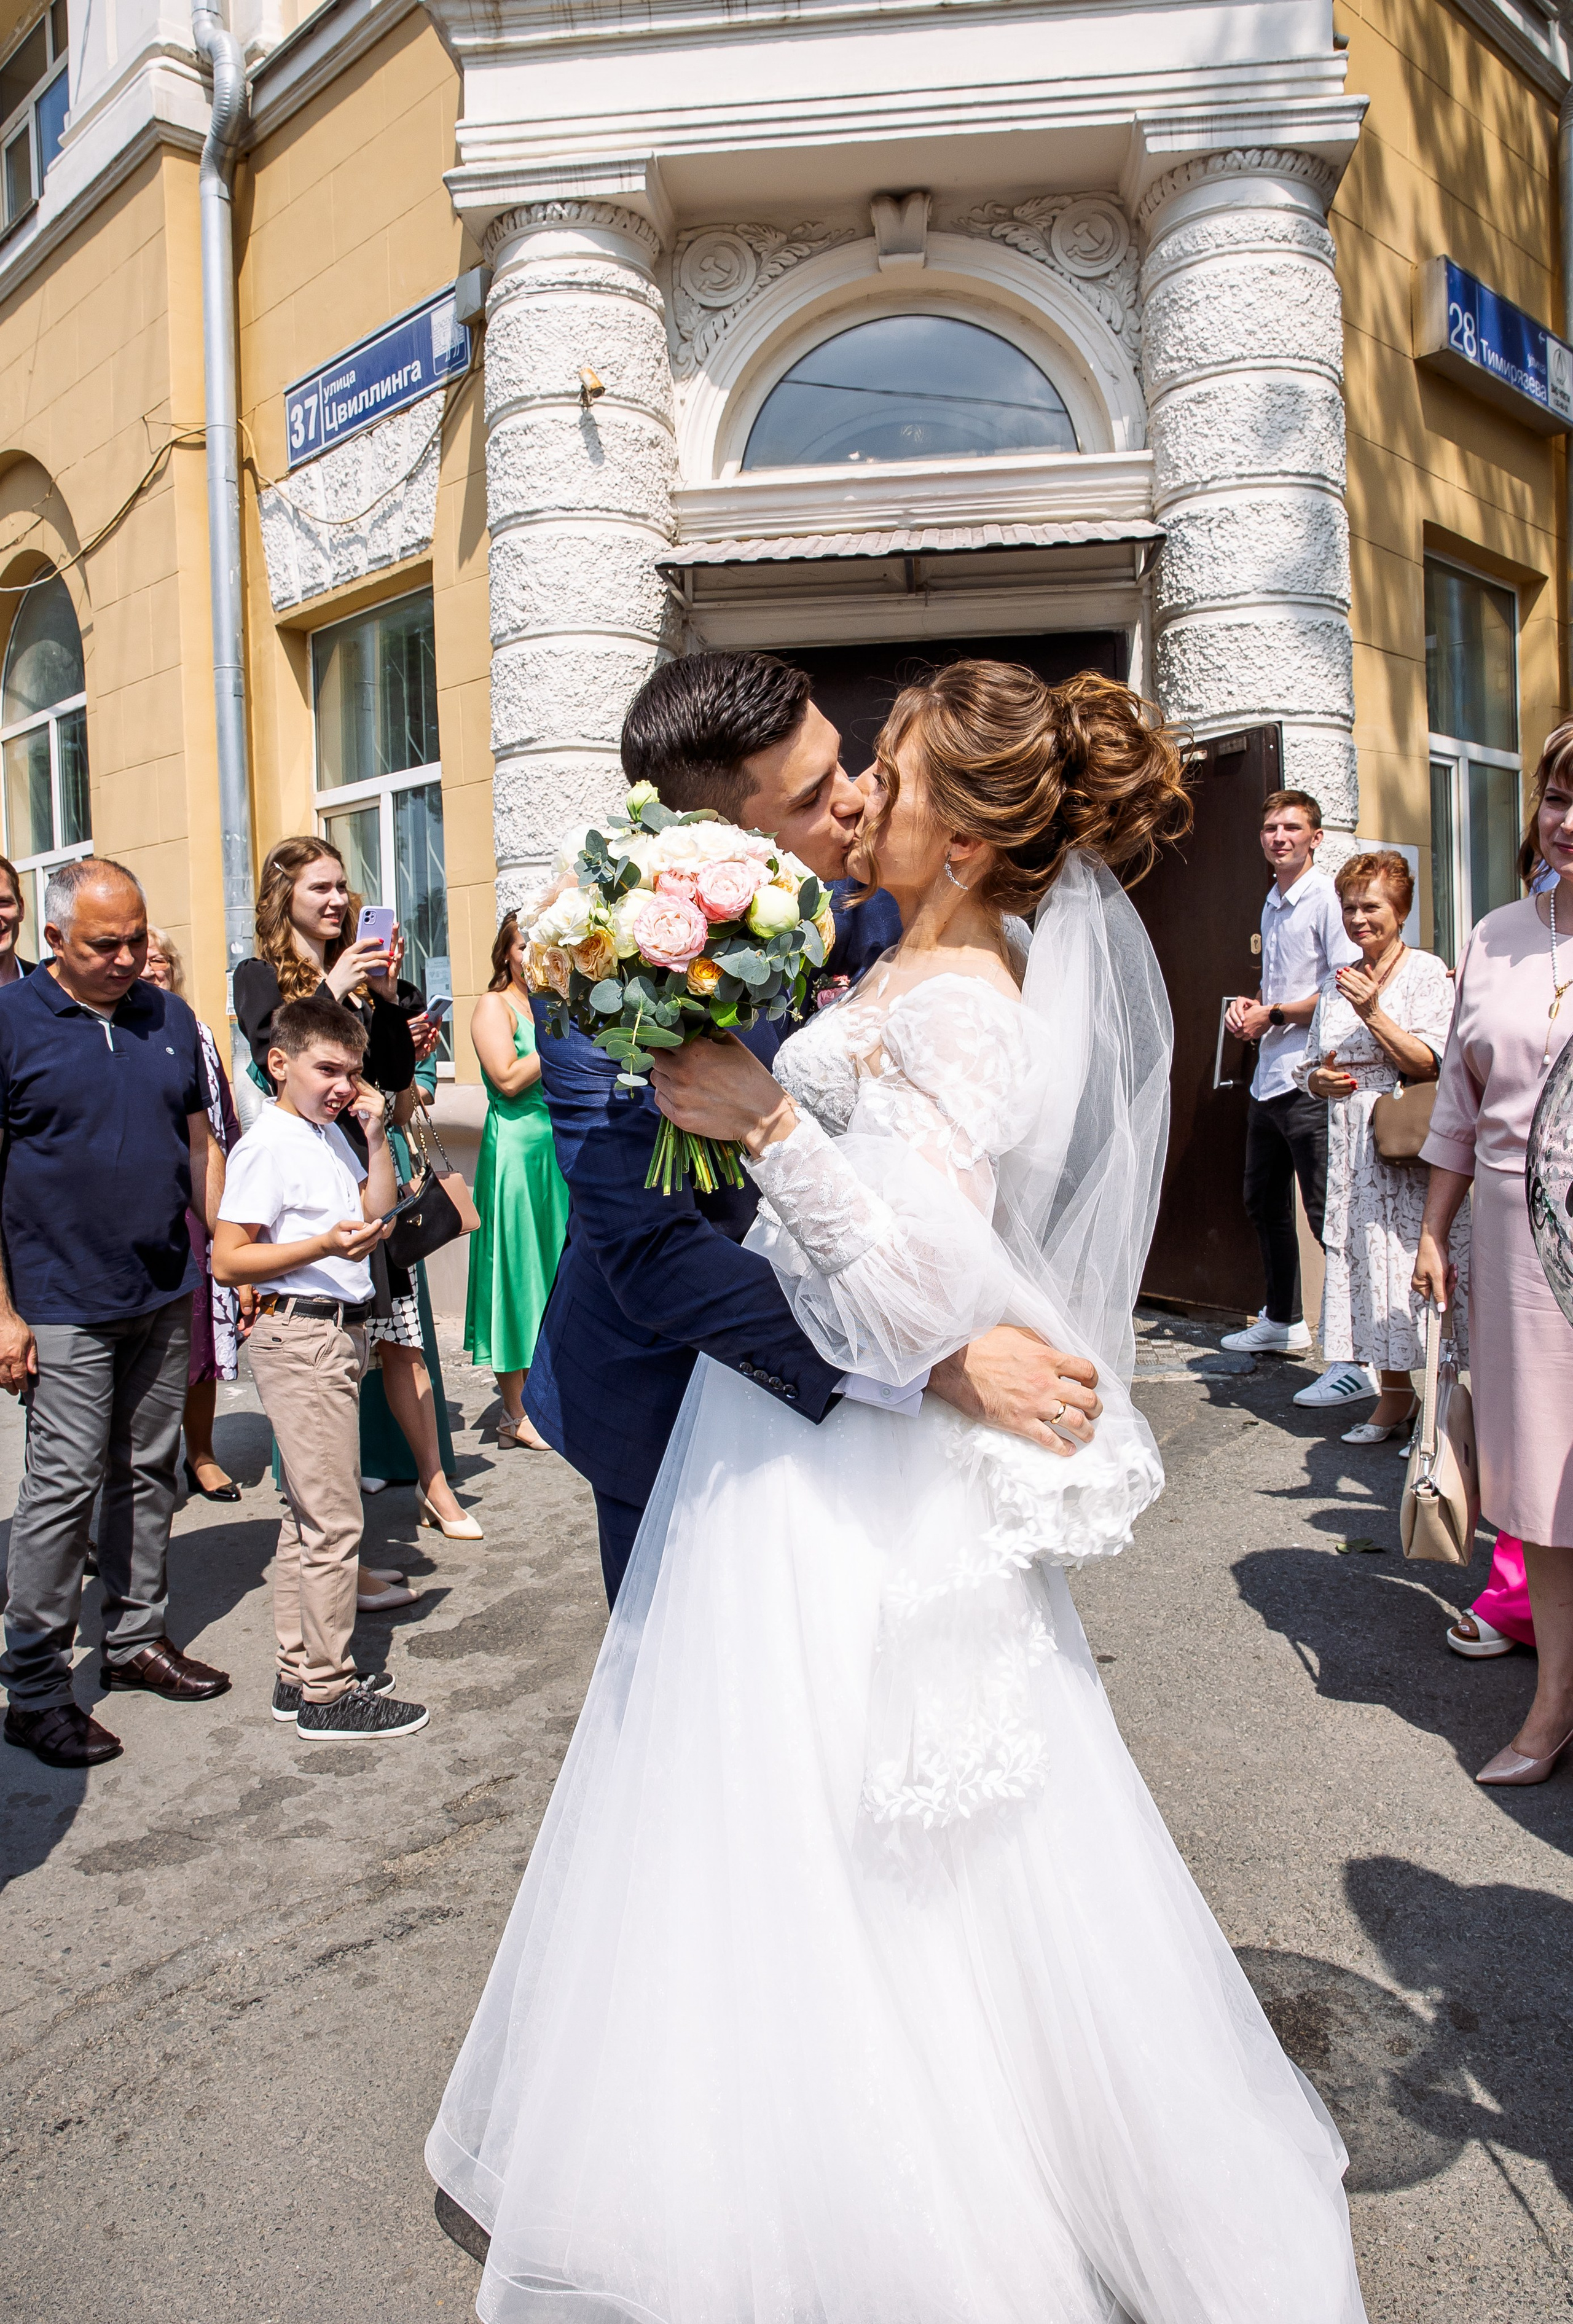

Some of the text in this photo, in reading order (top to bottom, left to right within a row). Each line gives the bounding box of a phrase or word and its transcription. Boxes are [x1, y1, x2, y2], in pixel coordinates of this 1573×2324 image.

[1449, 302, 1477, 358] 28
[323, 370, 356, 404] улица
[324, 359, 422, 432] Цвиллинга
[1480, 338, 1547, 401] Тимирязева
[291, 394, 318, 449] 37
